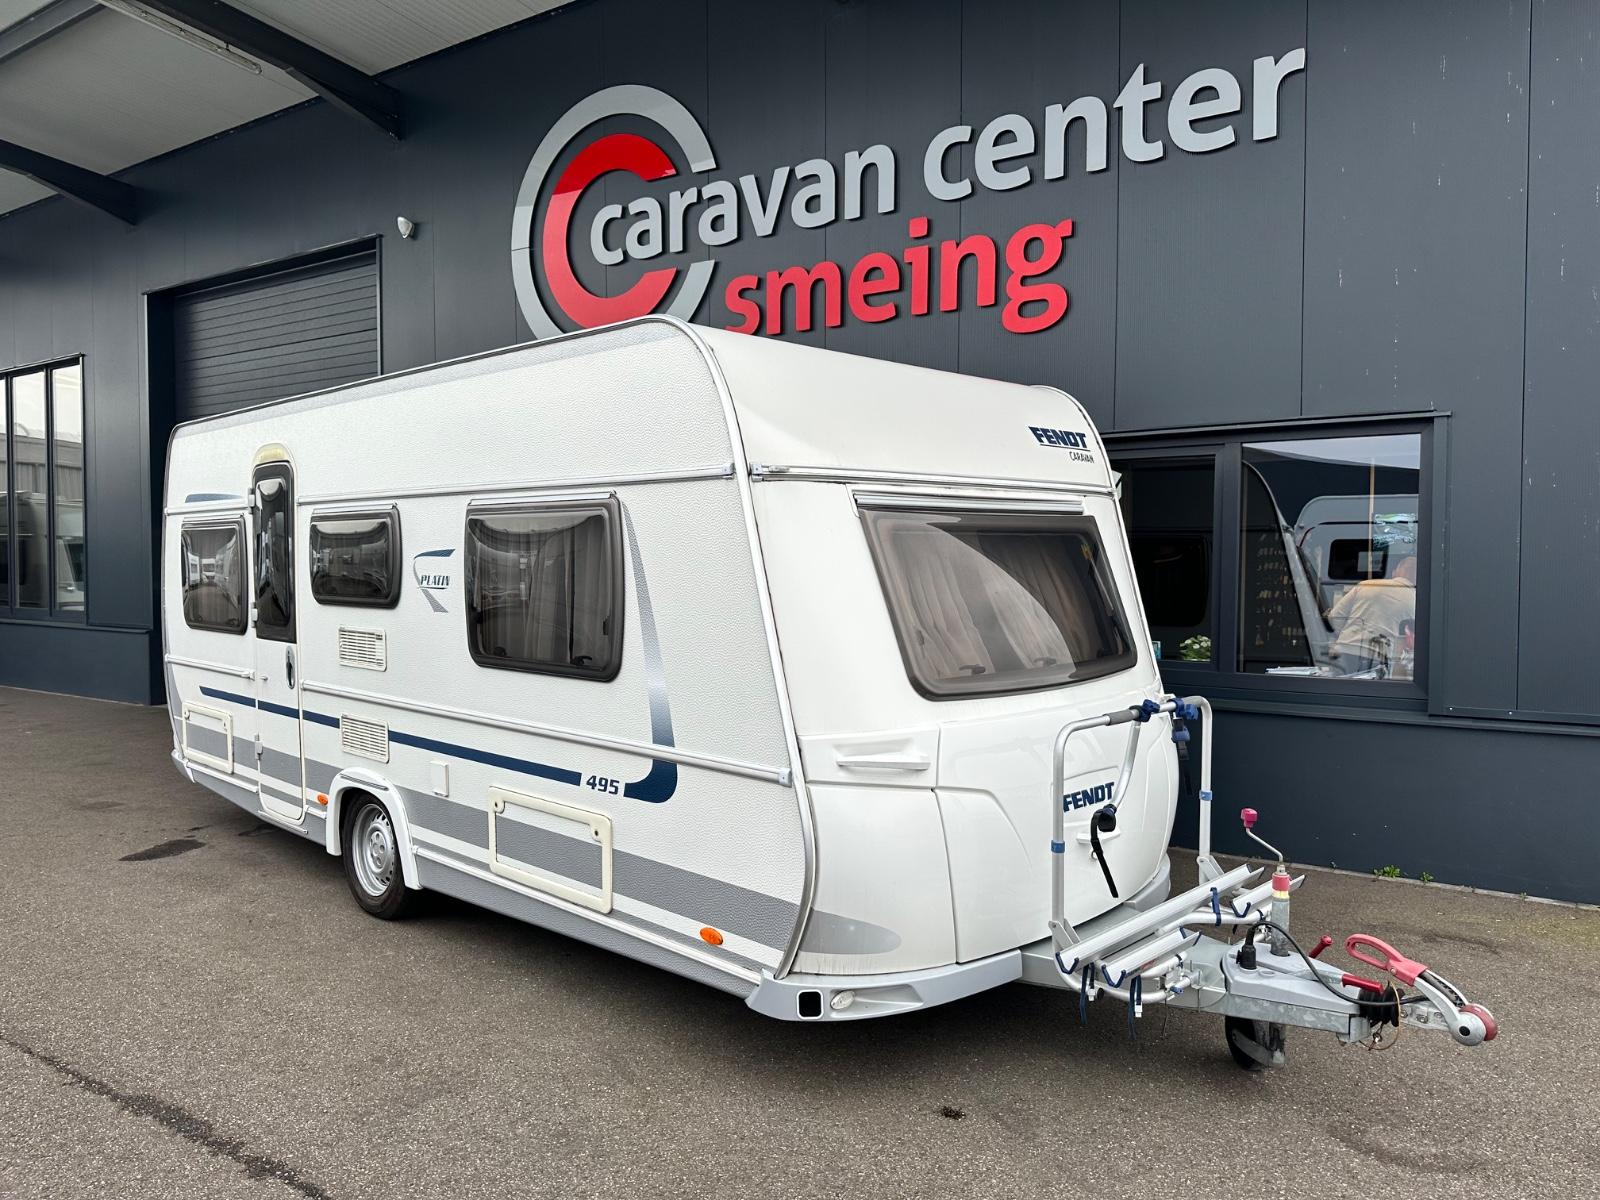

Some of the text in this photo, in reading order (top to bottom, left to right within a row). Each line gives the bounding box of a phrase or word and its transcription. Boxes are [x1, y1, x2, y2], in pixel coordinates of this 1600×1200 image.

[590, 47, 1306, 266] caravan center
[725, 216, 1074, 335] smeing
[1028, 426, 1088, 449] FENDT
[1069, 451, 1095, 464] CARAVAN
[420, 574, 450, 586] PLATIN
[586, 775, 620, 795] 495
[1062, 781, 1115, 813] FENDT
